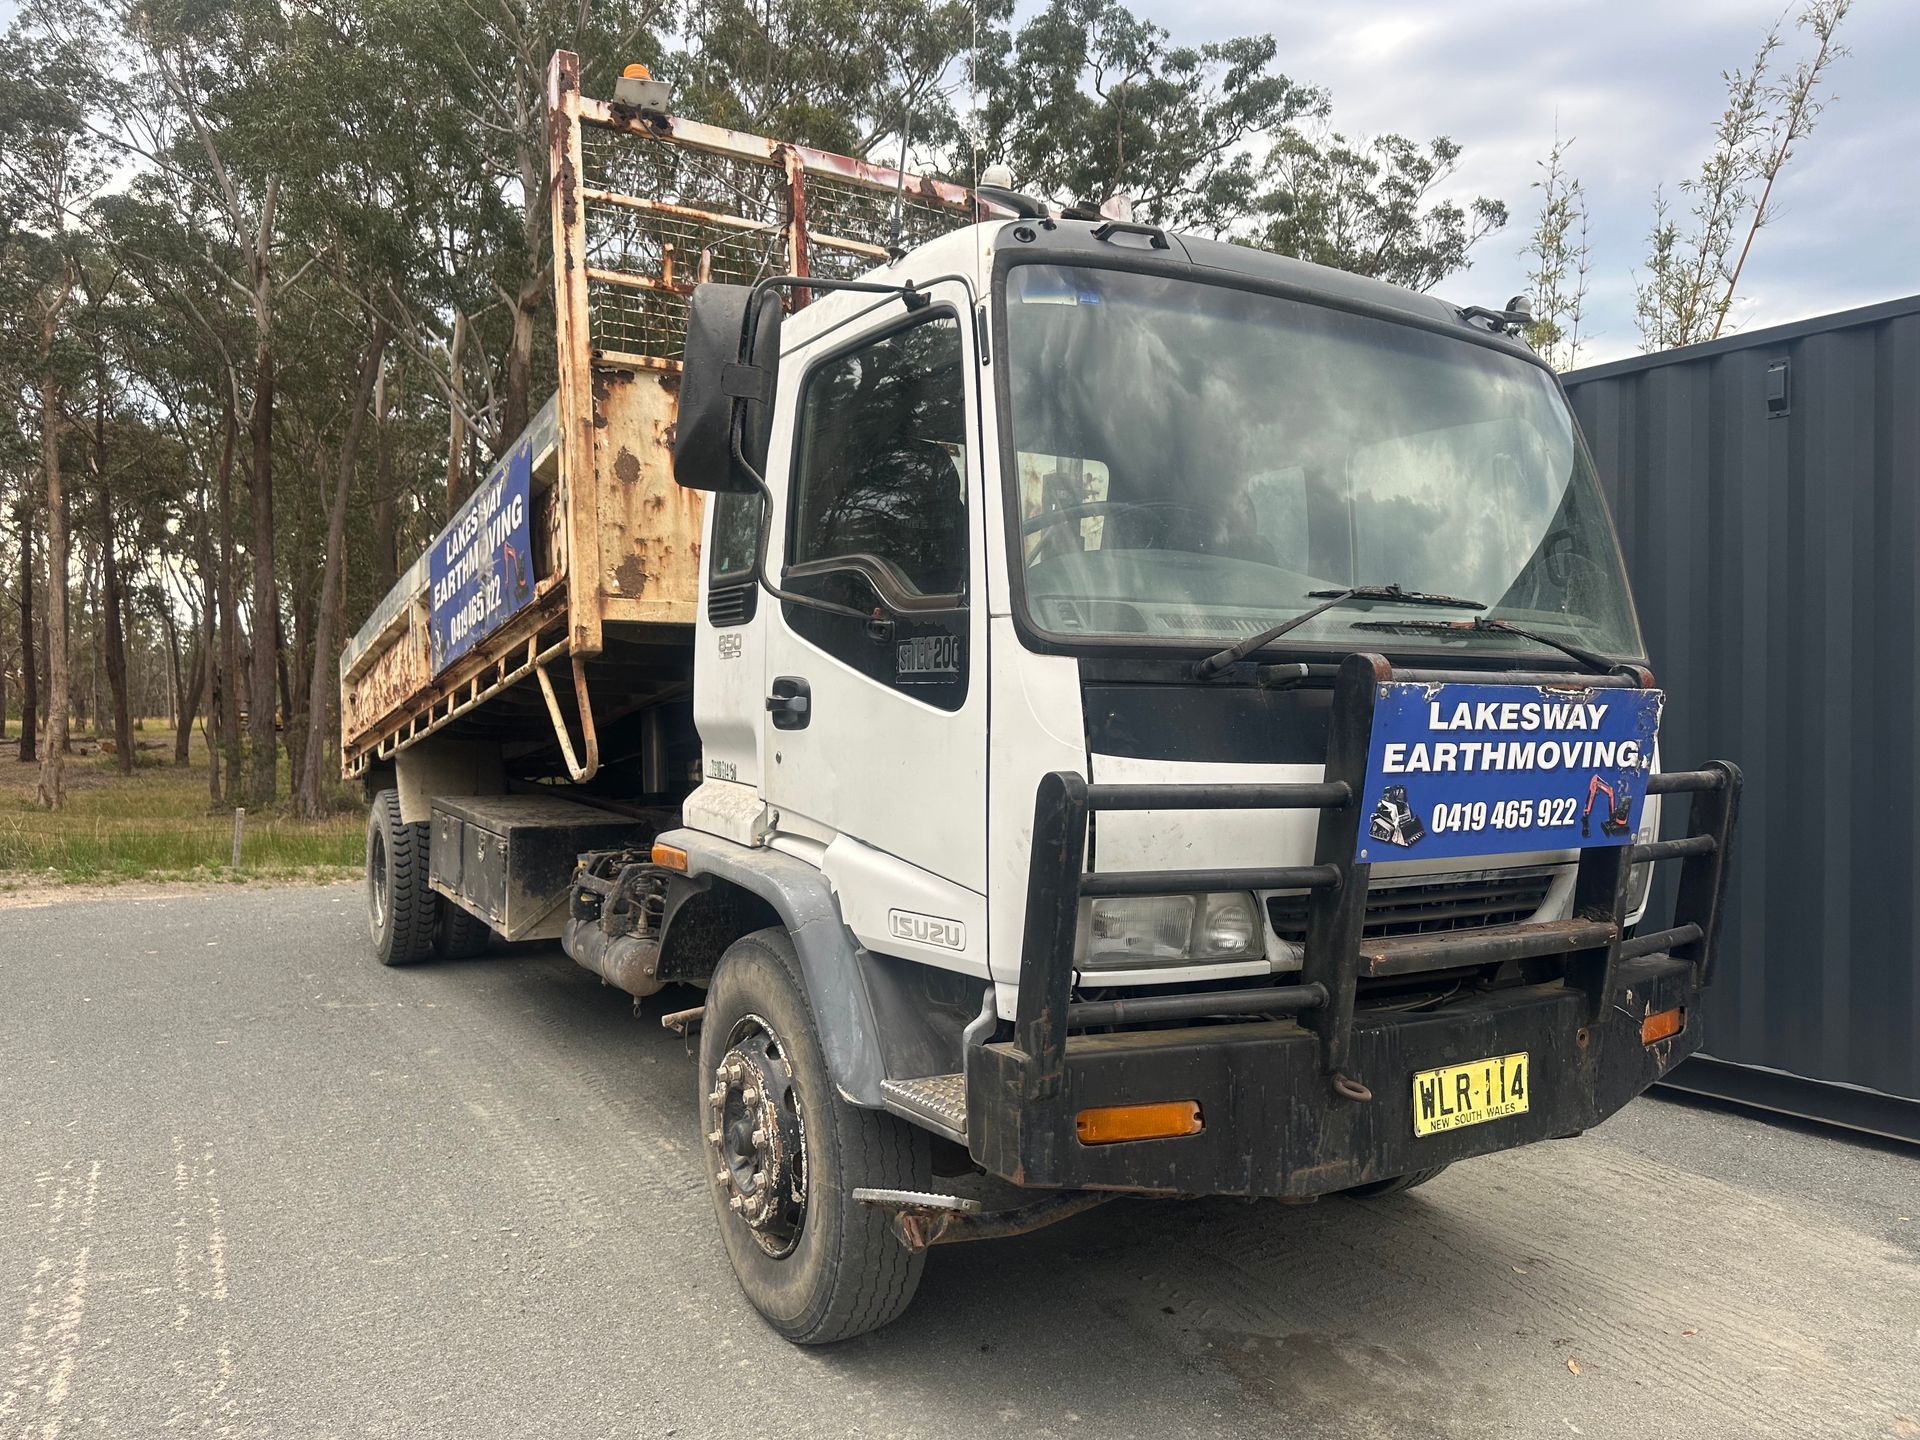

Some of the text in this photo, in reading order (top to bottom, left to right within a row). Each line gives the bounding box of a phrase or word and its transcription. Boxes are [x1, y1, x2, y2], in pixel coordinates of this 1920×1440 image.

[434, 493, 523, 613] EARTHMVING
[1428, 701, 1608, 731] LAKESWAY
[1382, 741, 1639, 774] EARTHMOVING
[1431, 798, 1577, 834] 0419 465 922
[893, 915, 960, 947] ISUZU
[1430, 1102, 1516, 1131] NEW SOUTH WALES
